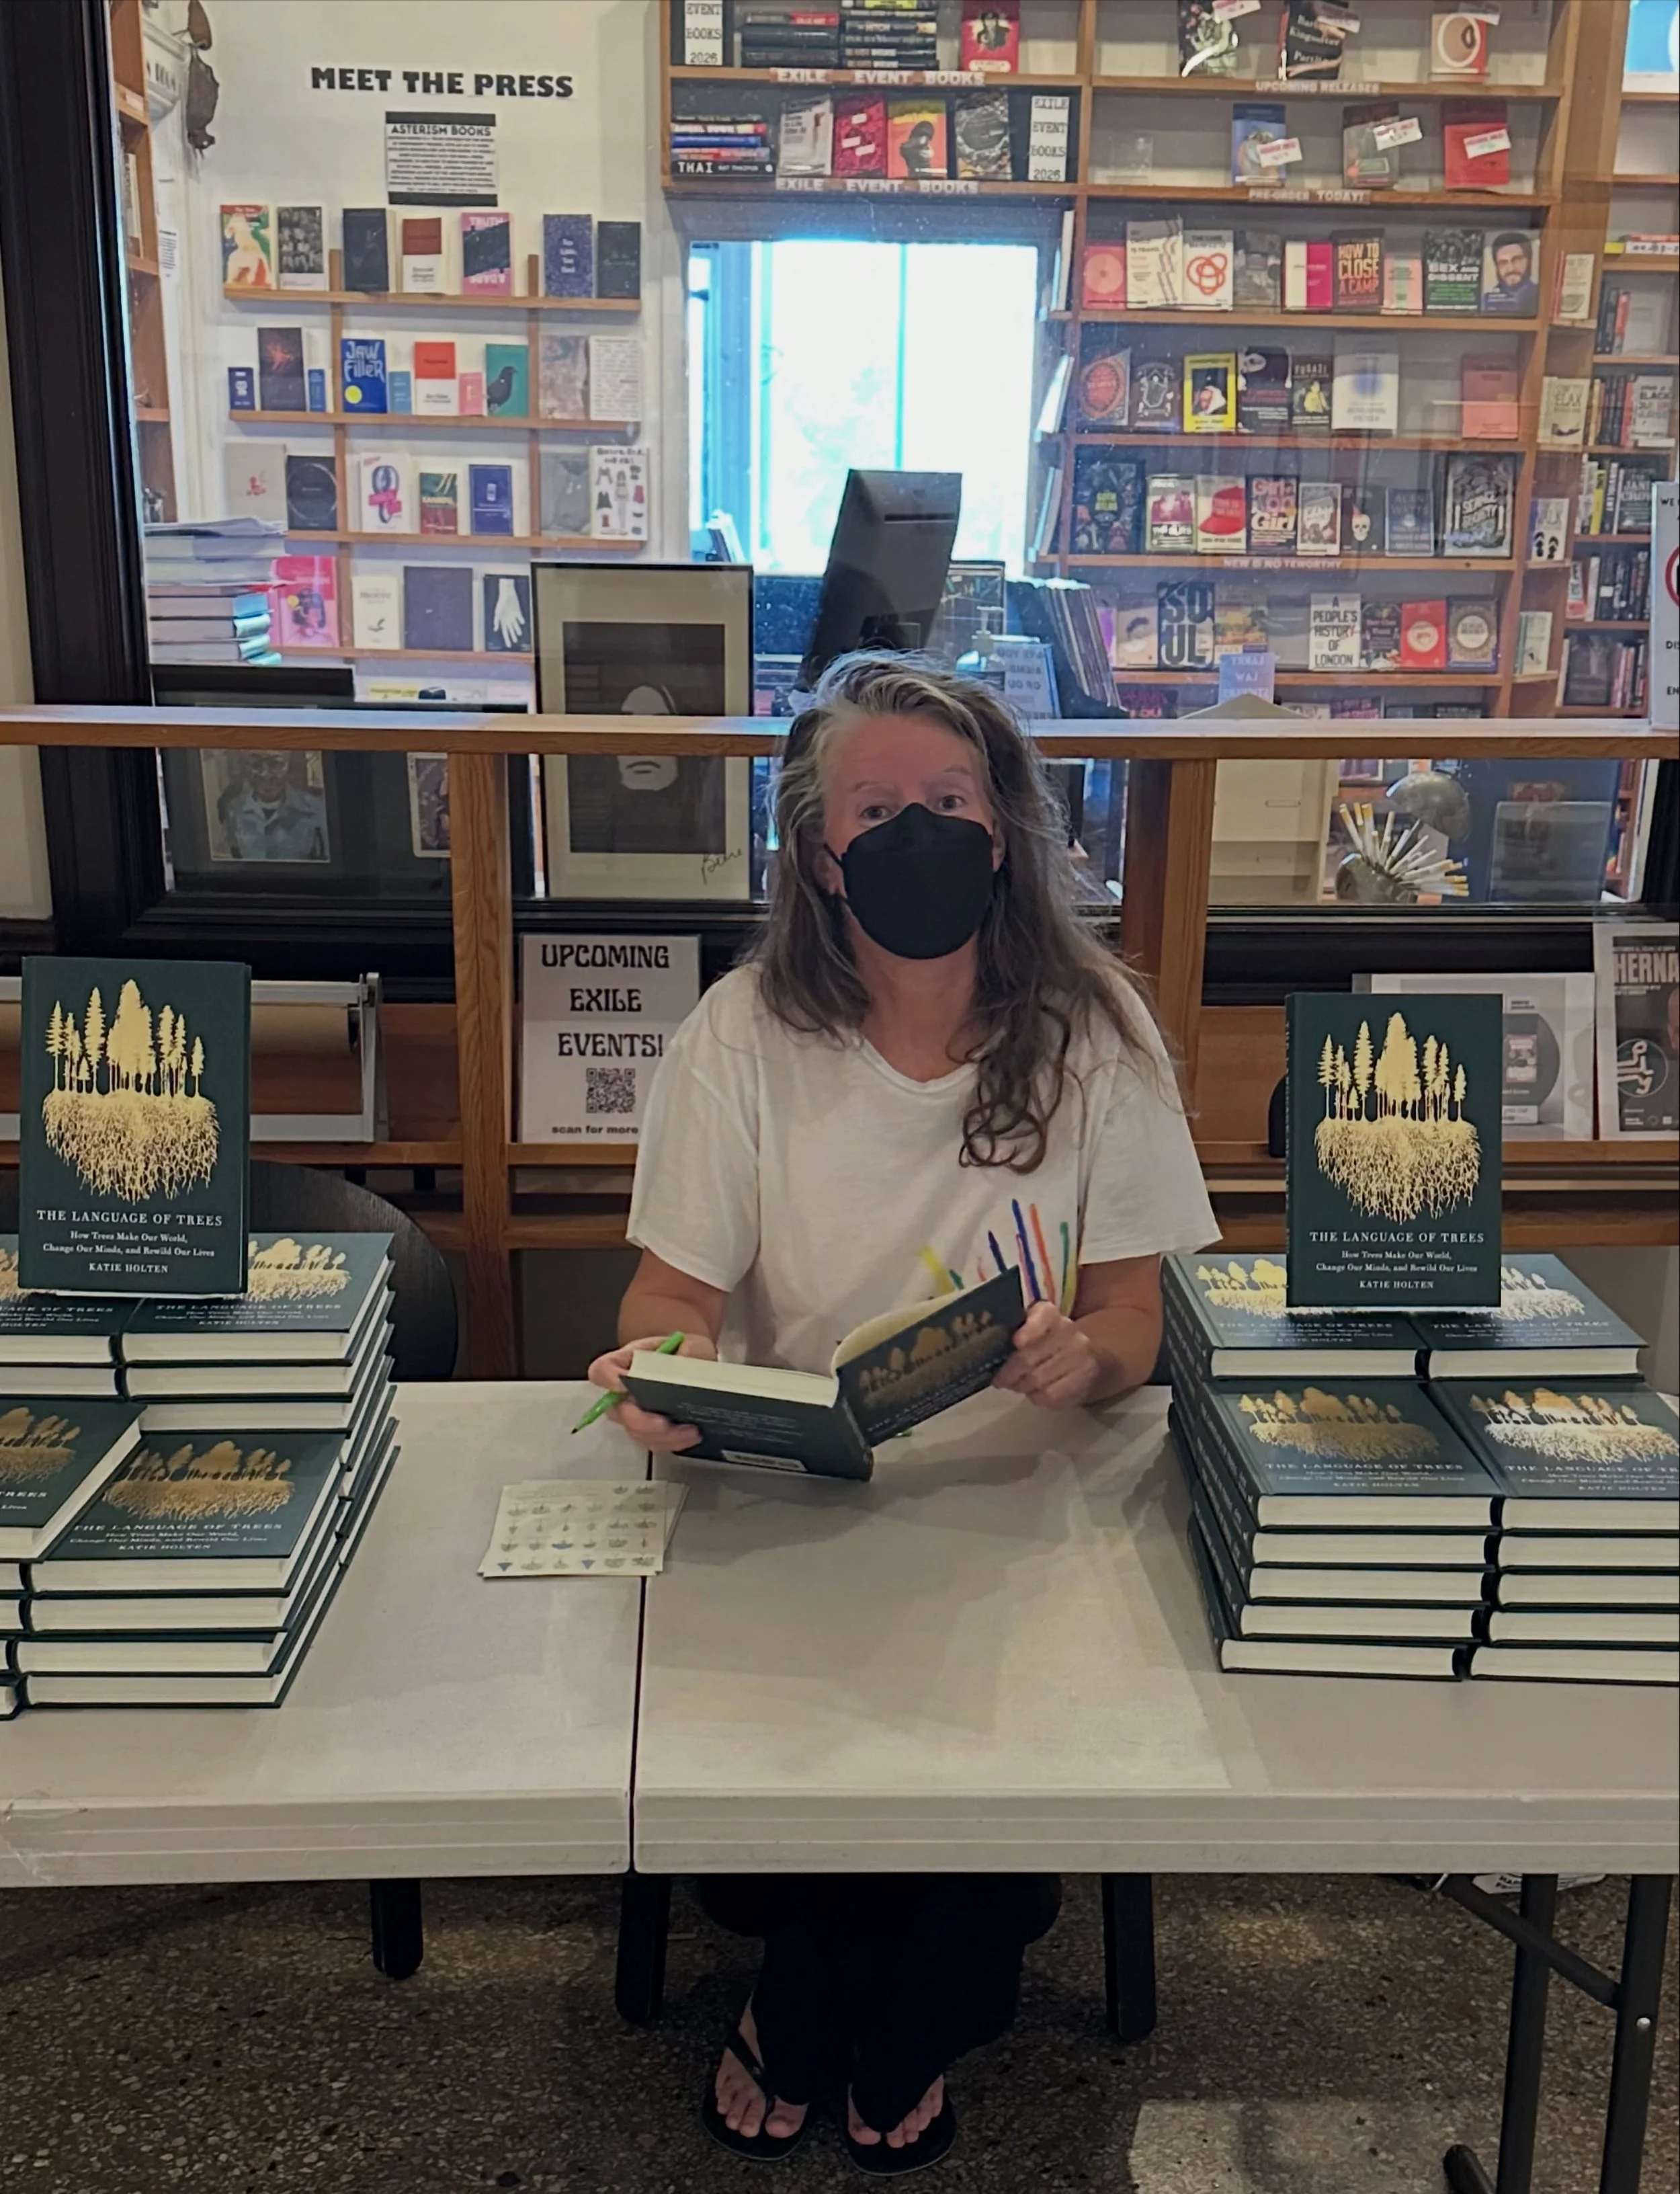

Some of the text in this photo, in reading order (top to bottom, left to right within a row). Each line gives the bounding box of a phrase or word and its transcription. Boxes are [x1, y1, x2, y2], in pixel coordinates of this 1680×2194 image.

[686, 3, 722, 15] EVENT
[686, 28, 722, 40] BOOKS
[311, 67, 573, 97] MEET THE PRESS
[778, 69, 984, 85] EXILE EVENT BOOKS
[1255, 81, 1378, 93] UPCOMING RELEASES
[1034, 98, 1068, 110] EXILE
[391, 124, 491, 136] ASTERISM BOOKS
[1033, 122, 1067, 134] EVENT
[1032, 146, 1066, 157] BOOKS
[677, 161, 714, 173] THAI
[777, 178, 978, 194] EXILE EVENT BOOKS
[1249, 190, 1310, 201] PRE-ORDER
[1338, 242, 1379, 259] HOW TO
[1338, 259, 1379, 280] CLOSE
[1428, 273, 1478, 282] DISSENT
[1339, 278, 1379, 294] A CAMP
[1395, 493, 1424, 503] ALAN
[1251, 512, 1296, 531] Girl
[1332, 596, 1339, 608] A
[1312, 610, 1357, 622] PEOPLE'S
[1328, 639, 1341, 651] OF
[1314, 654, 1353, 666] LONDON
[542, 944, 669, 968] UPCOMING
[570, 988, 642, 1012] EXILE
[558, 1033, 663, 1057] EVENTS!
[585, 1125, 603, 1135] for
[37, 1210, 222, 1227] THE LANGUAGE OF TREES
[70, 1231, 89, 1240] How
[91, 1231, 114, 1240] Trees
[116, 1232, 139, 1241] Make
[141, 1233, 158, 1242] Our
[1310, 1231, 1484, 1243] THE LANGUAGE OF TREES
[43, 1244, 74, 1254] Change
[76, 1245, 93, 1253] Our
[125, 1246, 141, 1254] and
[143, 1247, 172, 1256] Rewild
[174, 1248, 191, 1256] Our
[193, 1248, 215, 1257] Lives
[1341, 1250, 1359, 1258] How
[1384, 1251, 1406, 1259] Make
[1408, 1251, 1424, 1259] Our
[89, 1262, 168, 1273] KATIE HOLTEN
[1316, 1263, 1345, 1273] Change
[1347, 1264, 1363, 1272] Our
[1393, 1264, 1408, 1272] and
[1439, 1264, 1455, 1272] Our
[1359, 1281, 1434, 1289] KATIE HOLTEN
